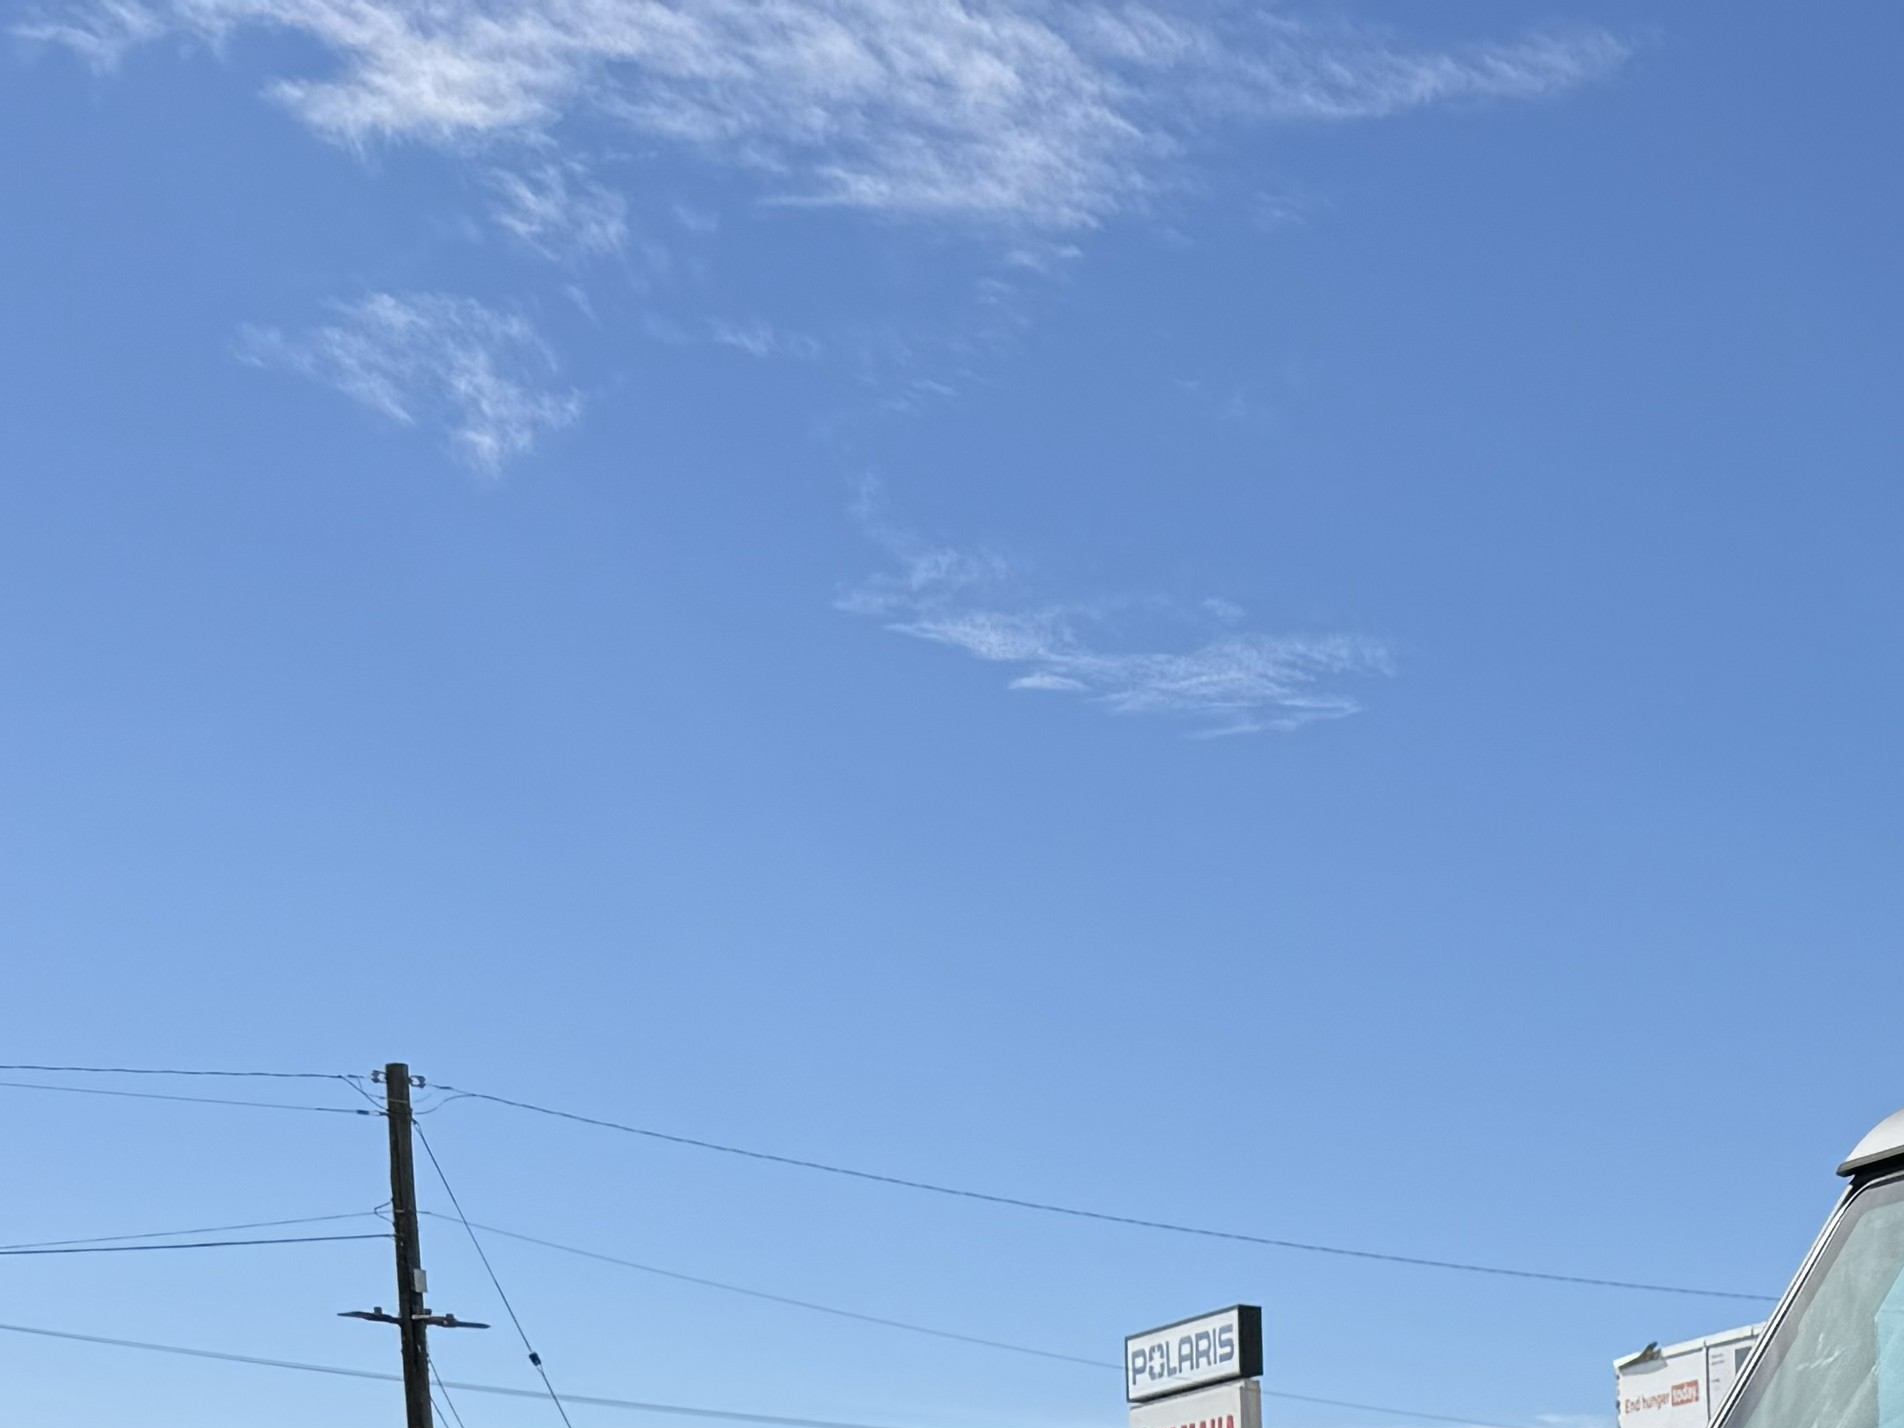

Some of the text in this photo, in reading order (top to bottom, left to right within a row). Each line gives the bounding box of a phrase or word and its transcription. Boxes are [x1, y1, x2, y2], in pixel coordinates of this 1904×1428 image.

[1131, 1323, 1235, 1386] POLARIS
[1625, 1395, 1641, 1414] End
[1643, 1393, 1670, 1411] hunger
